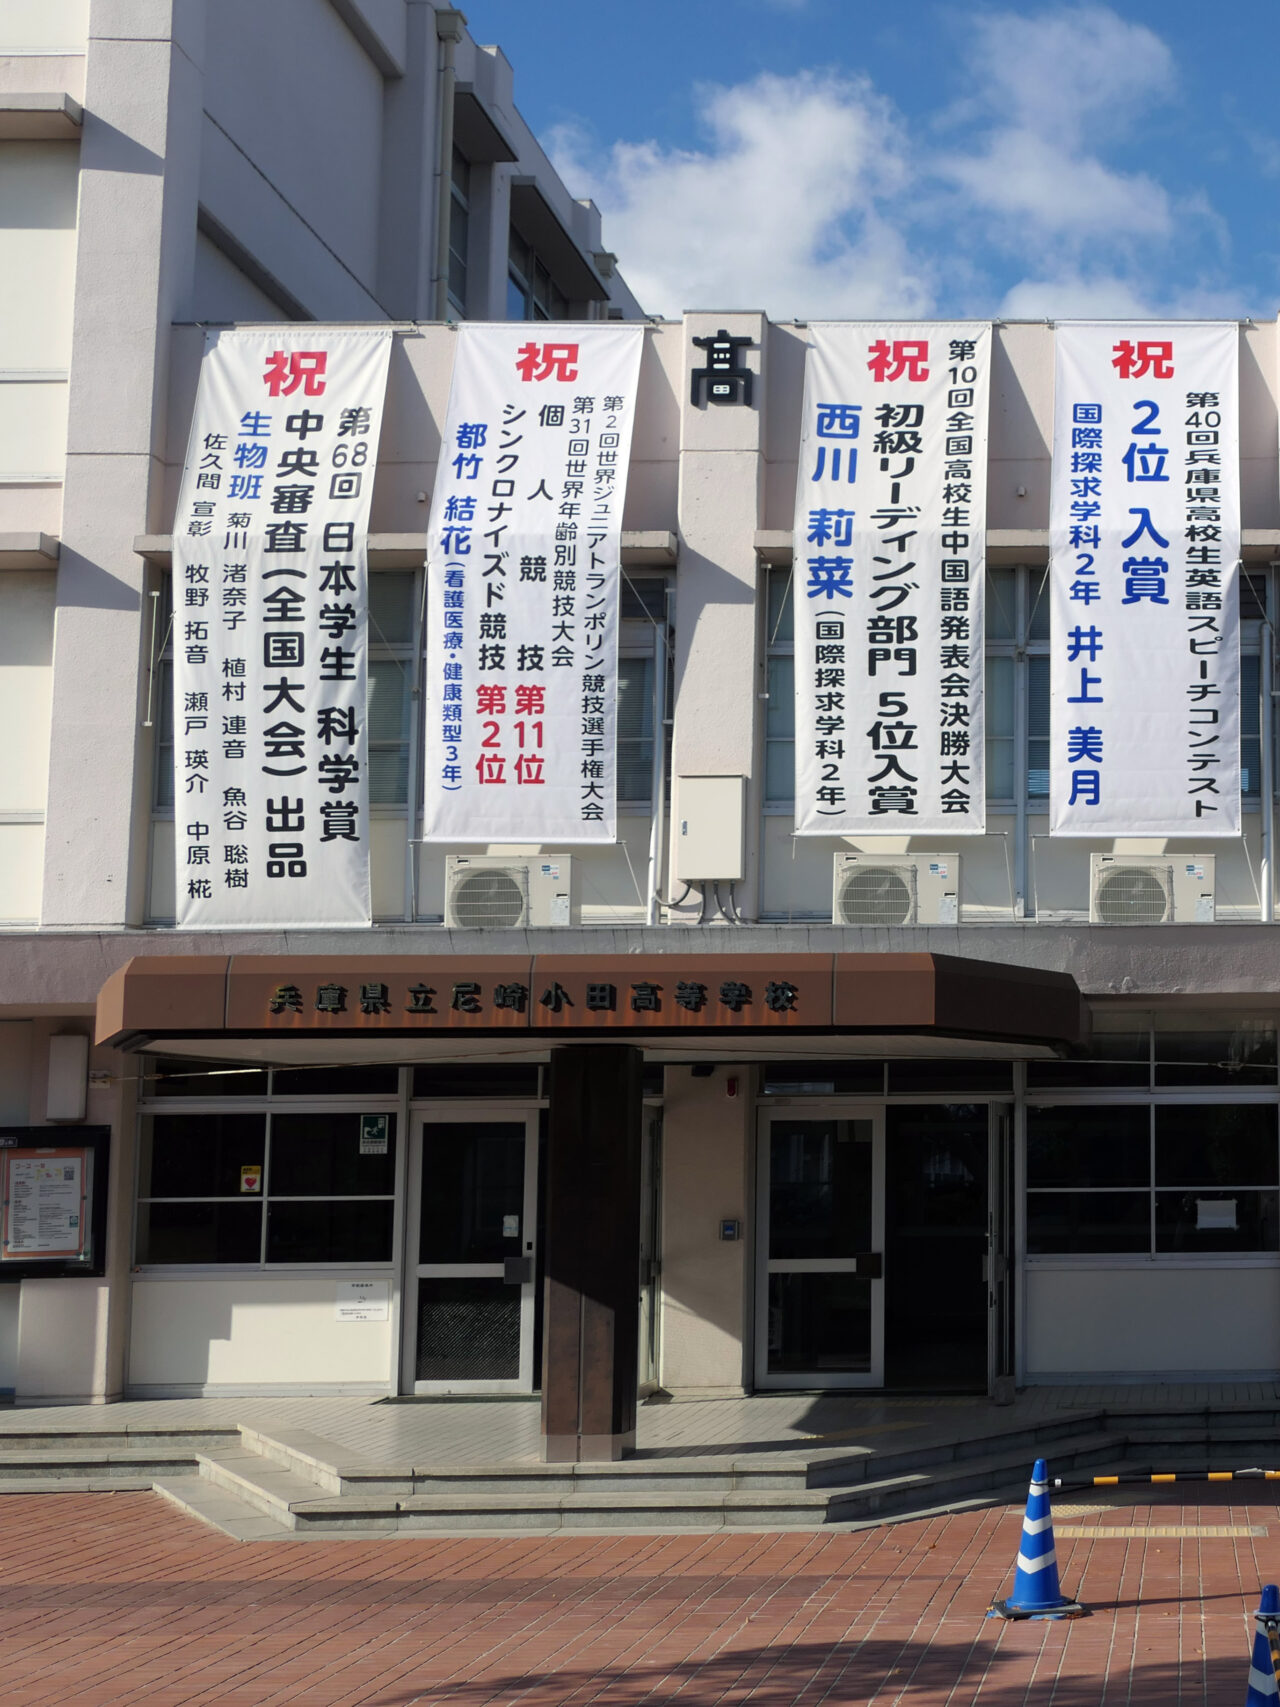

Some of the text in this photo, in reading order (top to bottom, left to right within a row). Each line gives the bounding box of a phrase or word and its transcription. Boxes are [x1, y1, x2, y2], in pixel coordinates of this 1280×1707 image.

[263, 350, 328, 397] 祝
[515, 342, 578, 382] 祝
[867, 340, 929, 382] 祝
[1112, 340, 1174, 379] 祝
[196, 433, 228, 490] 佐久間
[452, 422, 487, 480] 都竹
[811, 403, 863, 484] 西川
[187, 501, 216, 537] 宣彰
[551, 396, 595, 668] 第31回世界年齢別競技大会
[1121, 399, 1170, 605] 2位 入賞
[184, 564, 210, 608] 牧野
[806, 509, 854, 600] 莉菜
[939, 339, 977, 814] 第10回全国高校生中国語発表会決勝大会
[317, 406, 372, 842] 第68回 日本学生 科学賞
[580, 395, 625, 822] 第2回世界ジュニアトランポリン競技選手権大会
[866, 404, 925, 815] 初級リーディング部門 5位入賞
[1067, 403, 1104, 806] 国際探求学科2年 井上 美月
[1184, 391, 1223, 818] 第40回兵庫県高校生英語スピーチコンテスト
[184, 621, 209, 666] 拓音
[222, 412, 272, 888] 生物班 菊川 渚奈子 植村 連音 魚谷 聡樹
[184, 692, 209, 735] 瀬戸
[475, 684, 507, 784] 第2位
[513, 684, 546, 784] 第11位
[184, 750, 210, 794] 瑛介
[186, 822, 211, 865] 中原
[270, 981, 799, 1013] 兵庫県立尼崎小田高等学校
